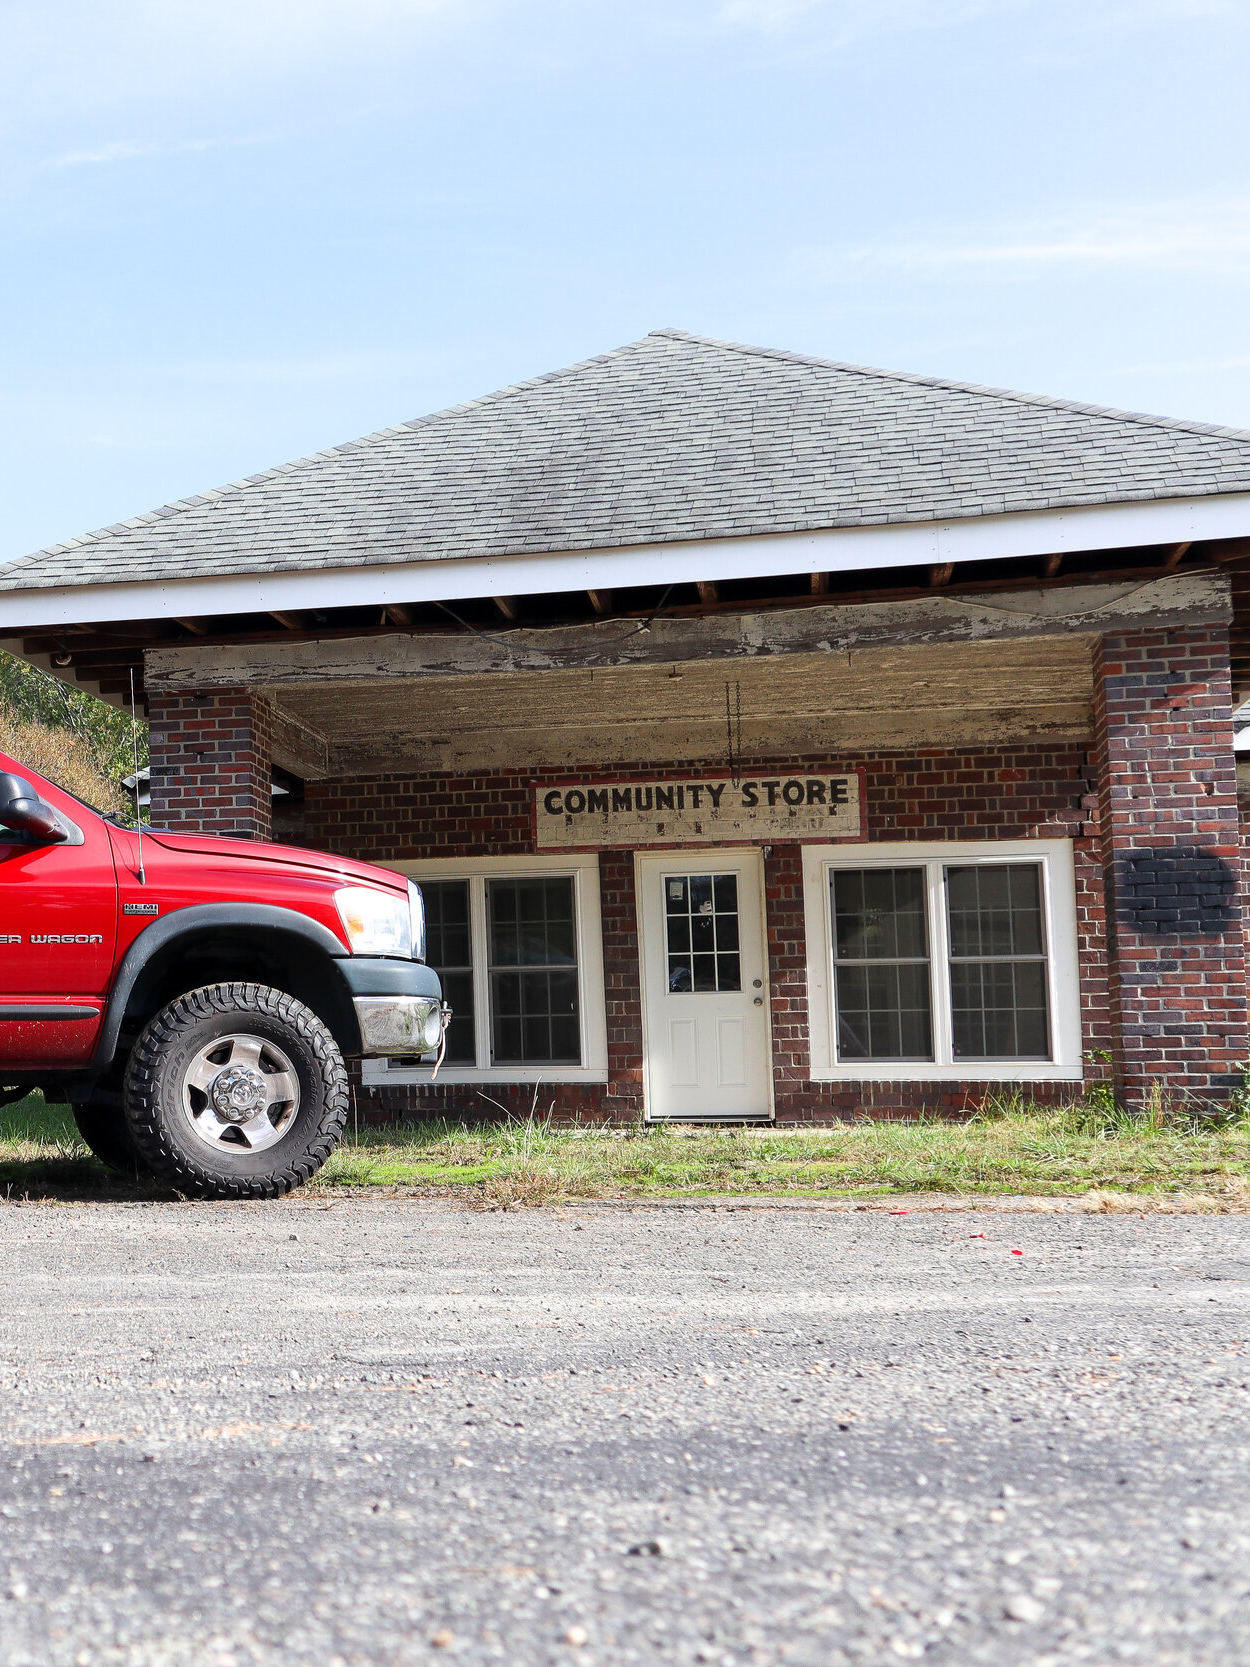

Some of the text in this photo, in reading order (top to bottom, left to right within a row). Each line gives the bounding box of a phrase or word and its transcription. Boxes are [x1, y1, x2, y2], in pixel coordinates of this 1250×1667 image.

[543, 778, 849, 815] COMMUNITY STORE
[125, 903, 158, 911] HEMI
[30, 934, 104, 944] WAGON
